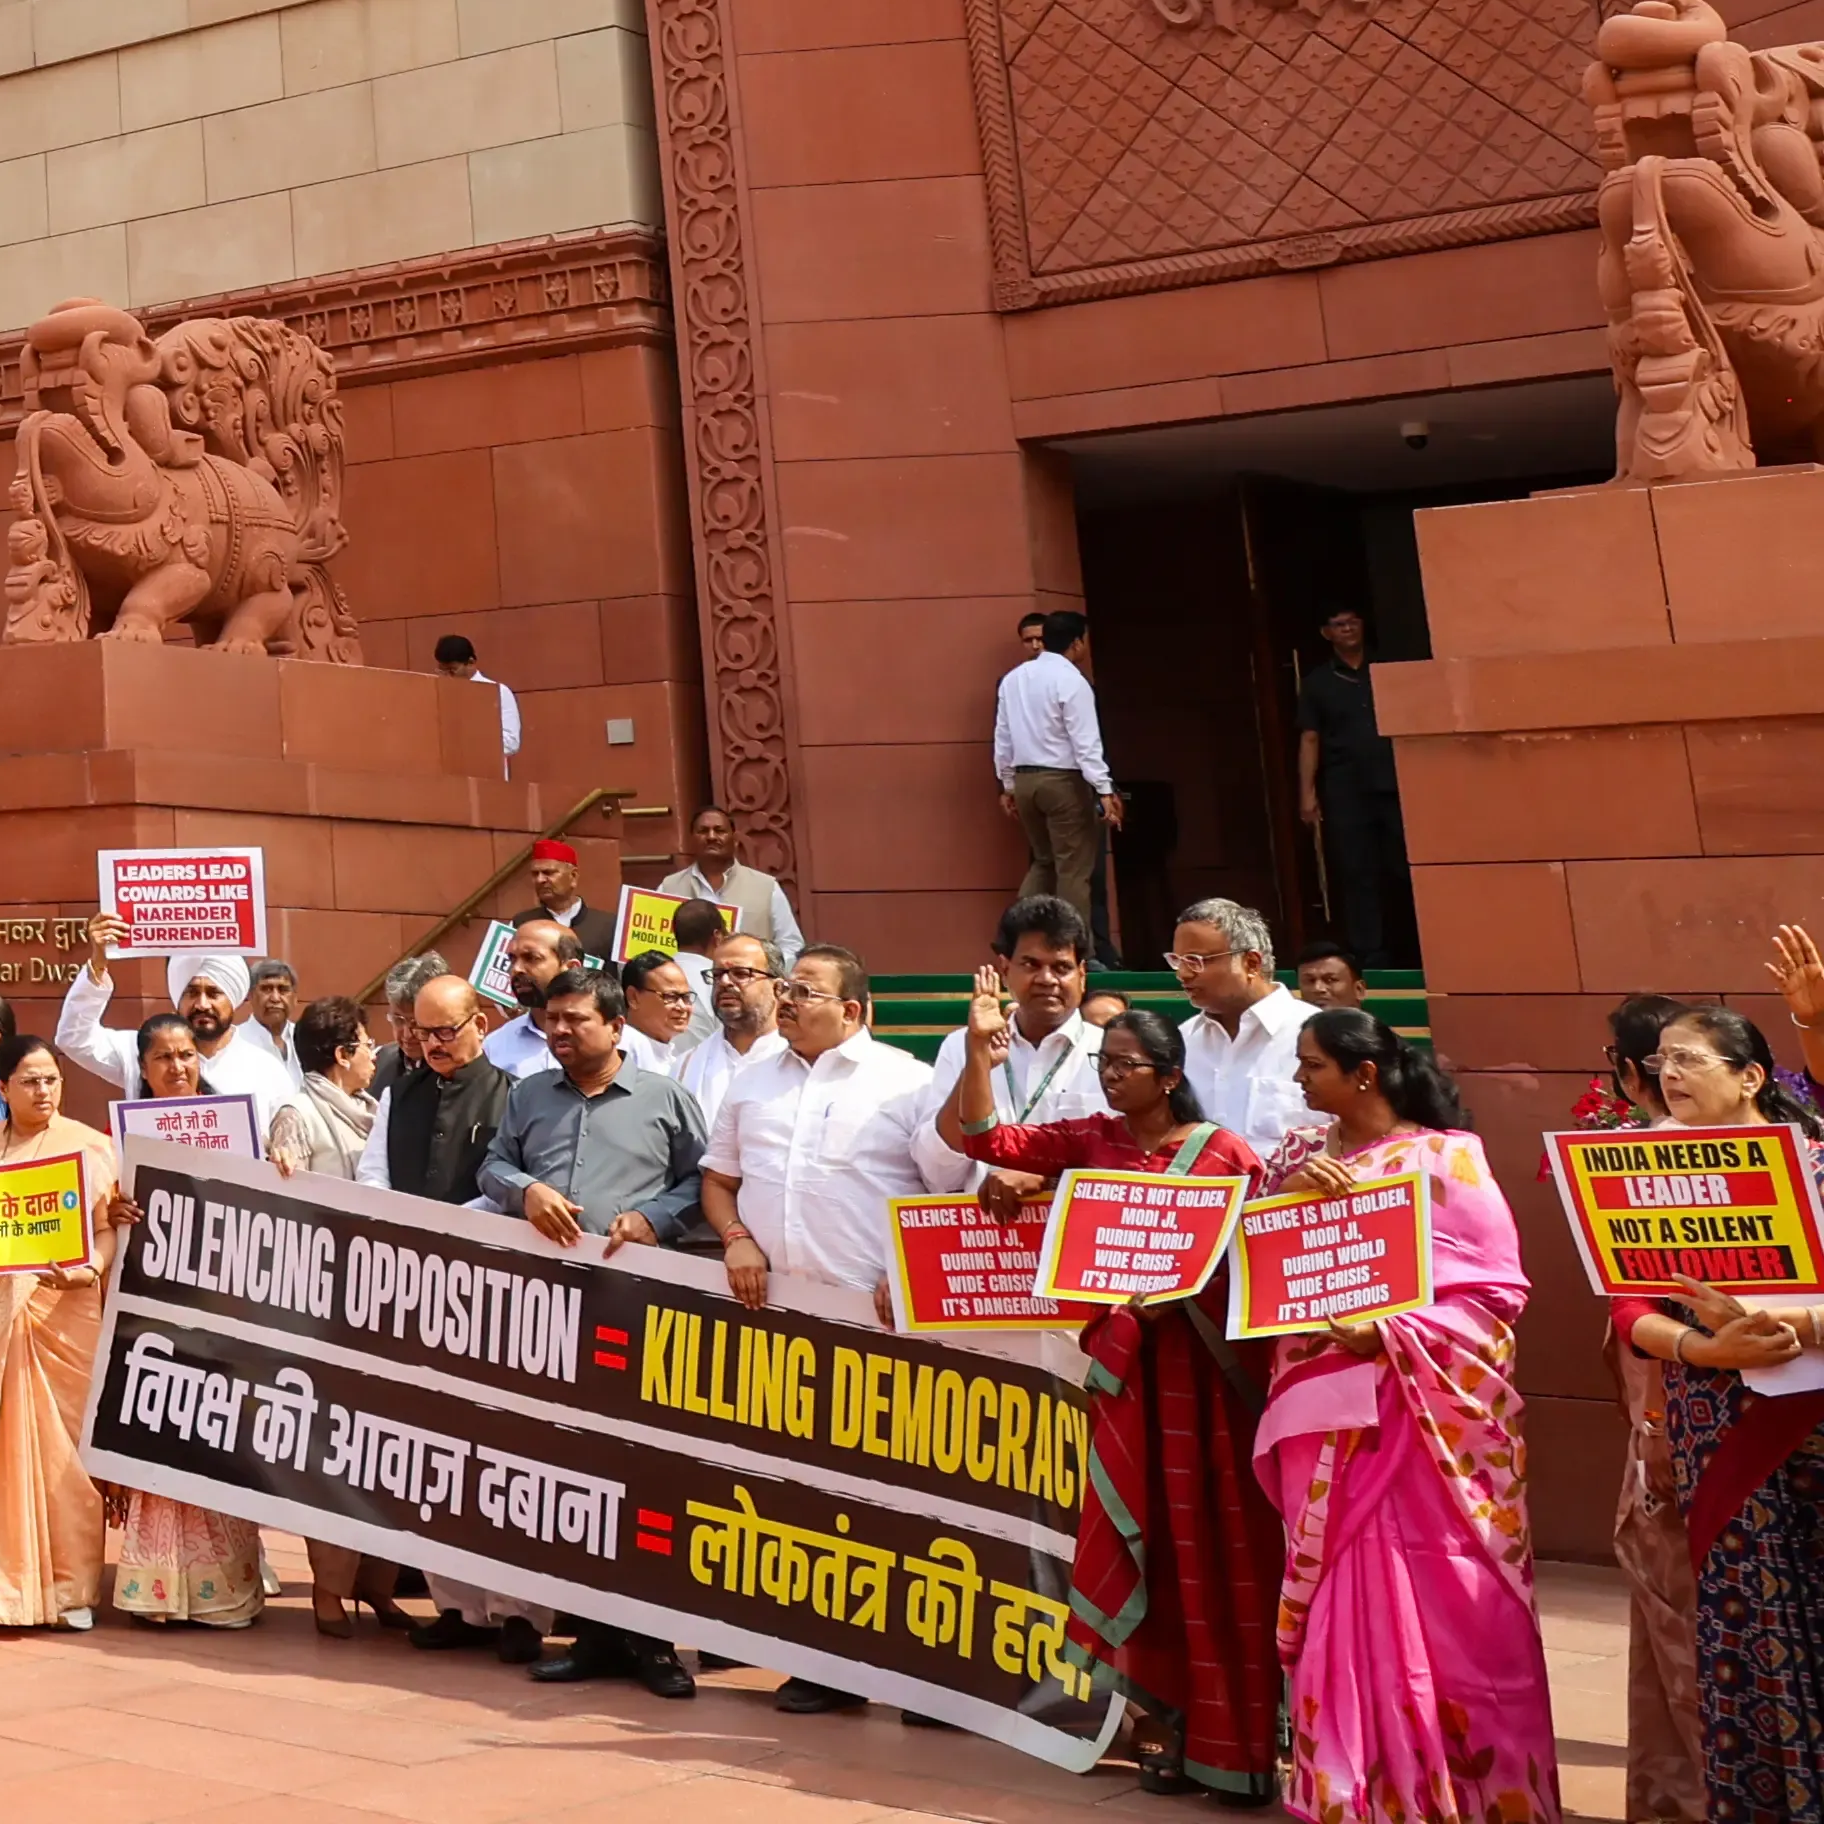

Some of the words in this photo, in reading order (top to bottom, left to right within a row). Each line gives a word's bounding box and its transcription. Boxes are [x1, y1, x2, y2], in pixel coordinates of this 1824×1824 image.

[117, 864, 196, 881] LEADERS
[200, 864, 246, 879] LEAD
[118, 886, 206, 902] COWARDS
[209, 884, 248, 900] LIKE
[137, 907, 232, 922] NARENDER
[633, 913, 656, 930] OIL
[133, 927, 238, 941] SURRENDER
[632, 932, 657, 944] MODI
[30, 958, 84, 982] Dwa
[155, 1113, 182, 1131] मोदी
[184, 1111, 199, 1129] जी
[202, 1110, 217, 1128] की
[1582, 1146, 1650, 1172] INDIA
[1655, 1141, 1741, 1170] NEEDS
[1748, 1141, 1768, 1166] A
[1074, 1183, 1127, 1202] SILENCE
[1129, 1186, 1143, 1203] IS
[1147, 1188, 1174, 1206] NOT
[1624, 1174, 1731, 1207] LEADER
[0, 1192, 19, 1217] के
[24, 1191, 59, 1216] दाम
[12, 1220, 25, 1236] के
[27, 1219, 60, 1235] भाषण
[900, 1208, 958, 1228] SILENCE
[961, 1208, 976, 1225] IS
[1121, 1207, 1159, 1226] MODI
[1244, 1207, 1300, 1236] SILENCE
[1302, 1205, 1317, 1225] IS
[1320, 1200, 1348, 1220] NOT
[960, 1230, 1000, 1248] MODI
[1095, 1227, 1146, 1247] DURING
[1149, 1233, 1194, 1249] WORLD
[1302, 1224, 1341, 1249] MODI
[1608, 1218, 1651, 1243] NOT
[1661, 1217, 1677, 1243] A
[1683, 1215, 1773, 1242] SILENT
[941, 1252, 994, 1271] DURING
[1095, 1249, 1130, 1267] WIDE
[1132, 1253, 1174, 1271] CRISIS
[1283, 1250, 1335, 1276] DURING
[1337, 1239, 1385, 1263] WORLD
[1620, 1248, 1785, 1280] FOLLOWER
[947, 1276, 984, 1293] WIDE
[1080, 1270, 1108, 1288] IT'S
[1109, 1273, 1181, 1292] DANGEROUS
[1287, 1275, 1323, 1298] WIDE
[1326, 1265, 1370, 1291] CRISIS
[942, 1298, 970, 1316] IT'S
[974, 1298, 1059, 1315] DANGEROUS
[1278, 1302, 1306, 1321] IT'S
[1310, 1284, 1390, 1317] DANGEROUS
[142, 1188, 336, 1321] SILENCING
[345, 1235, 581, 1383] OPPOSITION
[641, 1304, 816, 1441] KILLING
[118, 1331, 248, 1453] विपक्ष
[251, 1366, 317, 1473] की
[322, 1403, 471, 1522] आवाज़
[476, 1442, 626, 1561] दबाना
[686, 1484, 897, 1633] लोकतंत्र
[904, 1537, 982, 1660] की
